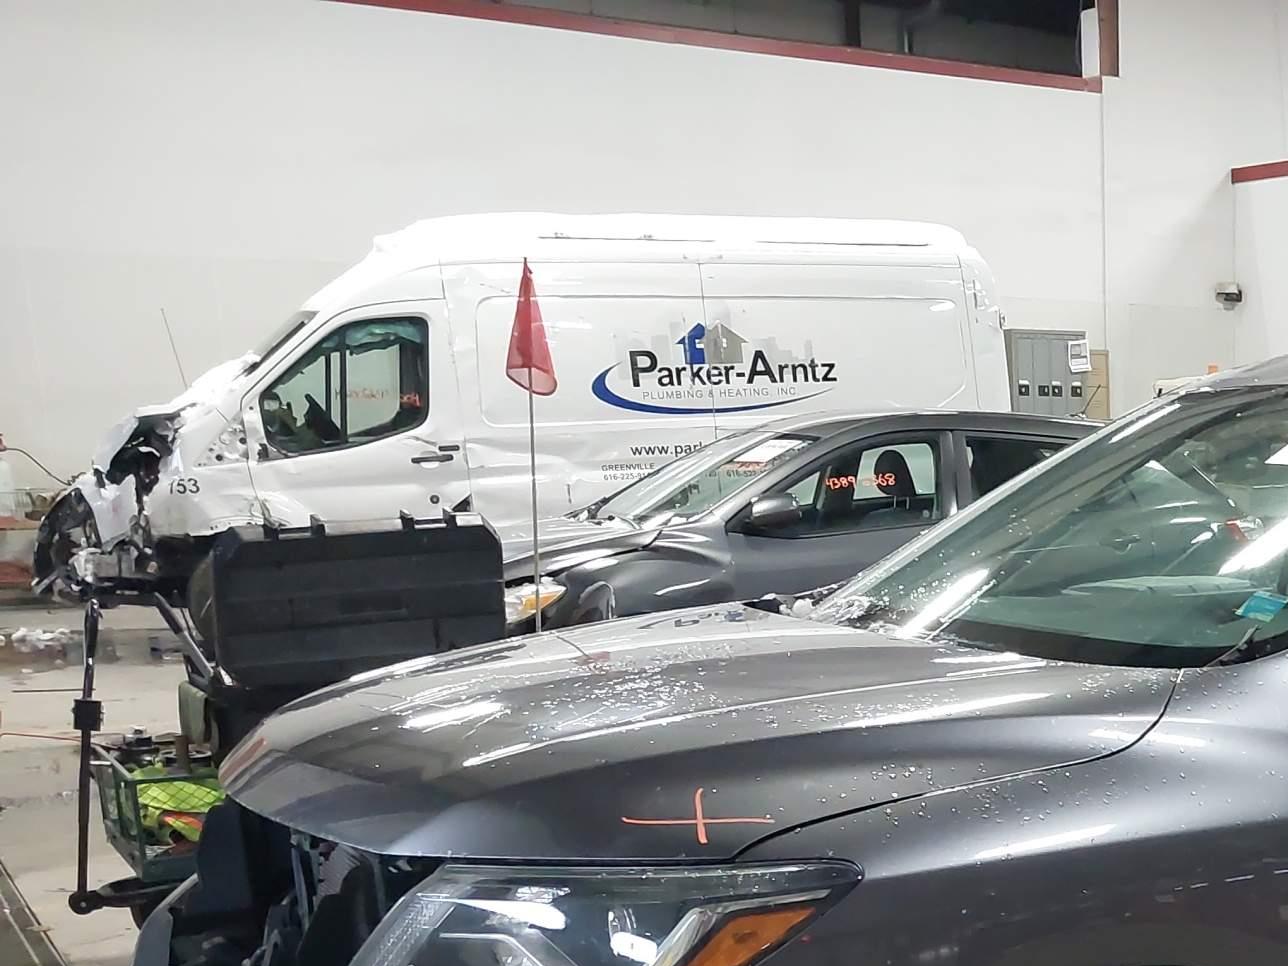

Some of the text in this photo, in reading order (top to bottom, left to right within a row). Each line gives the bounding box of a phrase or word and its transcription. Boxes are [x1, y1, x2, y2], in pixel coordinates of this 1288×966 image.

[628, 349, 838, 388] Parker-Arntz
[642, 389, 704, 400] PLUMBING
[601, 463, 655, 472] GREENVILLE
